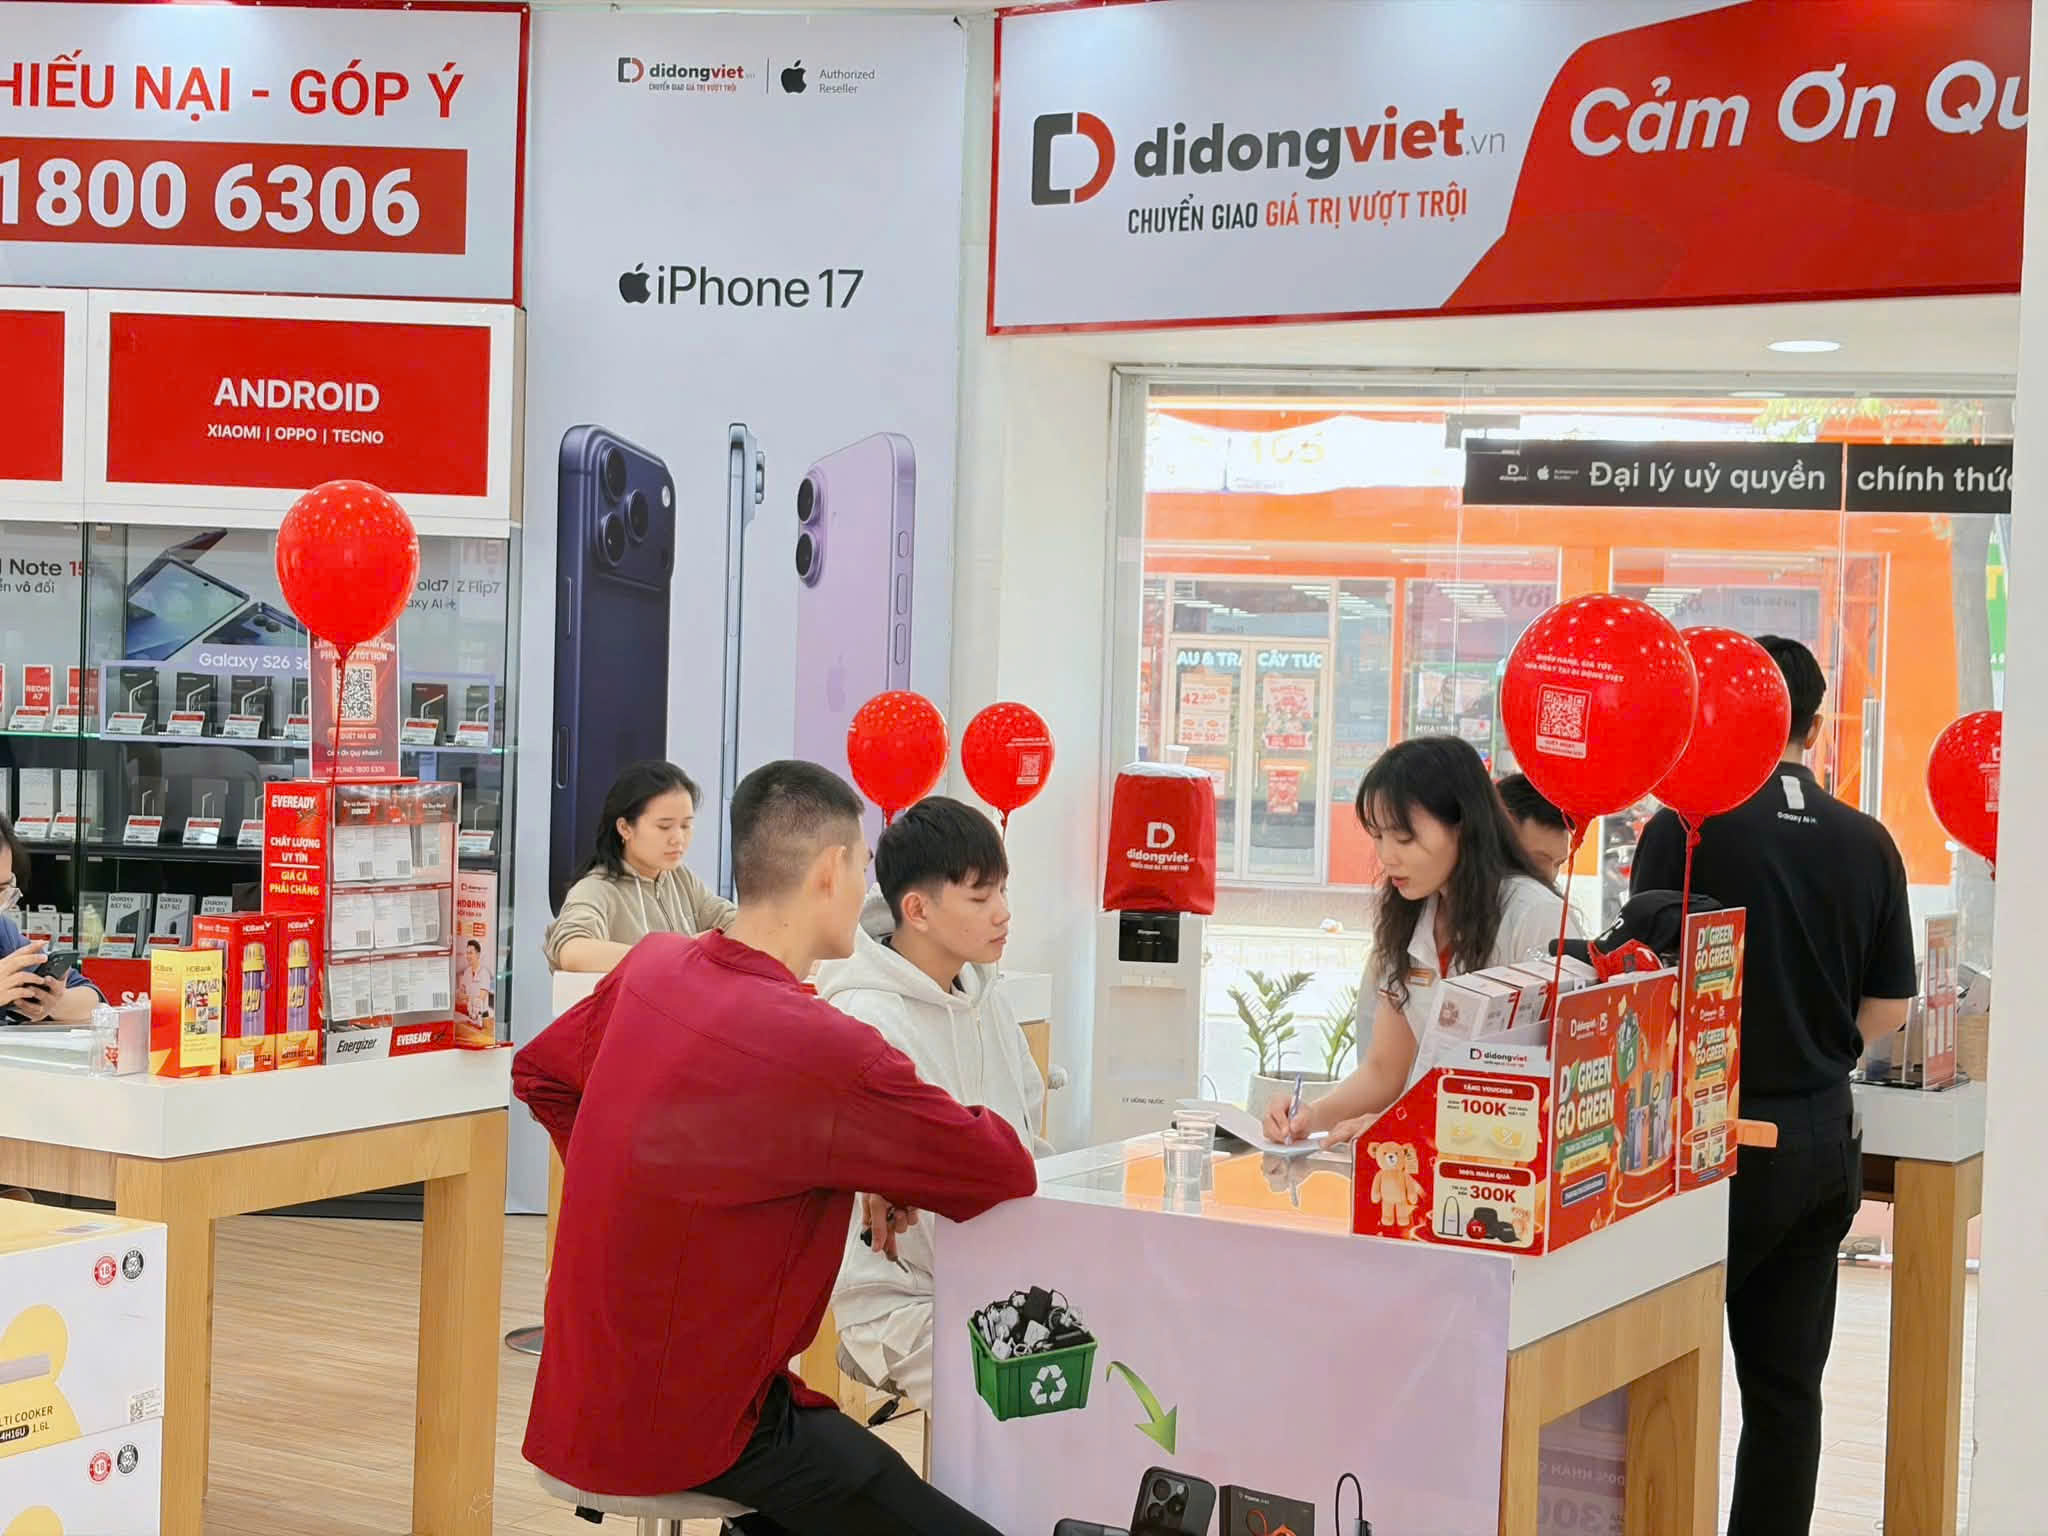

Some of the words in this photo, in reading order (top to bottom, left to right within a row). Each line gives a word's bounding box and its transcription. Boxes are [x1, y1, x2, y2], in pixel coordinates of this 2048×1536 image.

[819, 68, 875, 80] Authorized
[135, 65, 231, 122] NẠI
[289, 59, 409, 117] GÓP
[427, 62, 464, 118] Ý
[819, 84, 858, 94] Reseller
[1570, 76, 1750, 157] Cảm
[1777, 63, 1896, 143] Ơn
[0, 157, 186, 230] 1800
[213, 162, 419, 237] 6306
[1127, 192, 1203, 235] CHUYỂN
[1211, 203, 1258, 230] GIAO
[1265, 193, 1300, 227] GIÁ
[1307, 196, 1340, 228] TRỊ
[1348, 192, 1411, 226] VƯỢT
[1418, 182, 1468, 224] TRỘI
[656, 264, 810, 308] iPhone
[818, 268, 864, 309] 17
[213, 377, 380, 413] ANDROID
[207, 423, 261, 441] XIAOMI
[274, 426, 317, 443] OPPO
[331, 428, 384, 444] TECNO
[1589, 461, 1640, 492] Đại
[1650, 461, 1675, 492] lý
[1729, 460, 1826, 495] quyền
[1857, 465, 1945, 492] chính
[10, 559, 62, 577] Note
[417, 579, 449, 593] old7
[469, 582, 500, 598] Flip7
[406, 600, 429, 611] axy
[199, 653, 258, 671] Galaxy
[262, 656, 291, 669] S26
[272, 794, 315, 809] EVEREADY
[270, 835, 294, 848] CHẤT
[295, 836, 320, 850] LƯỢNG
[281, 850, 294, 861] UY
[337, 1037, 377, 1053] Energizer
[397, 1031, 432, 1046] EVEREADY
[1461, 1099, 1507, 1117] 100K
[1577, 1089, 1614, 1130] GREEN
[1470, 1185, 1516, 1203] 300K
[15, 1405, 53, 1424] COOKER
